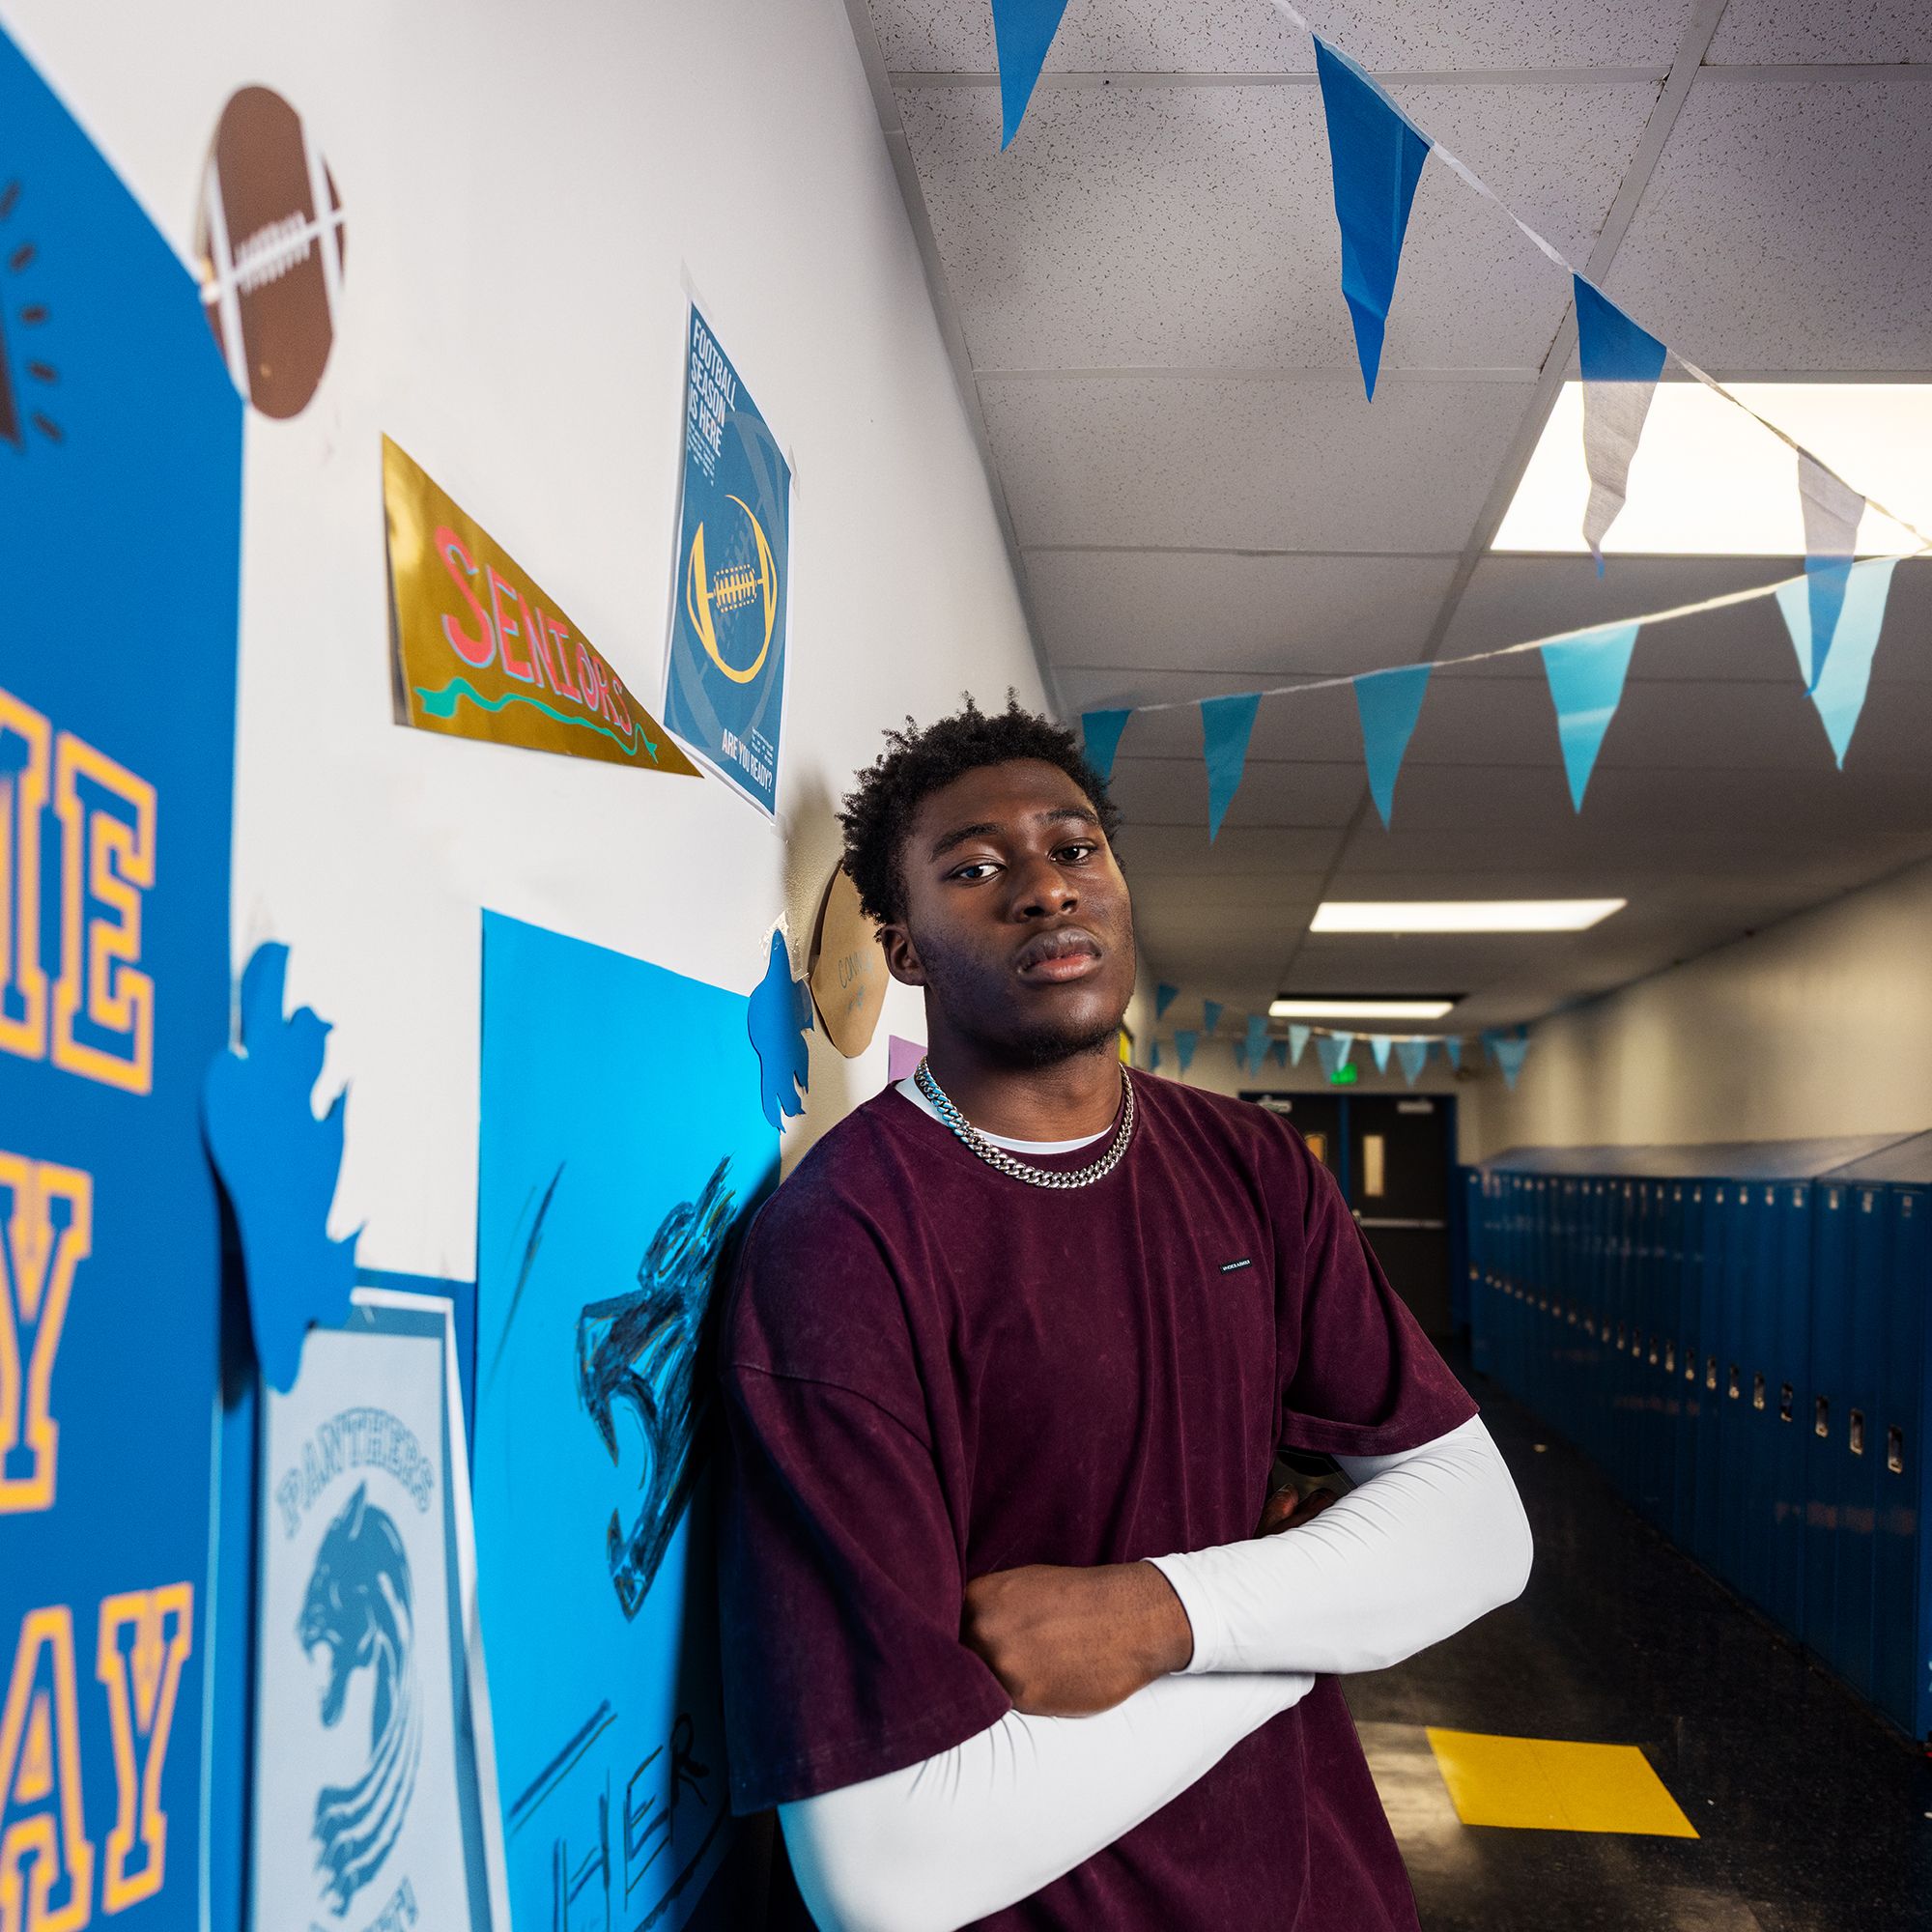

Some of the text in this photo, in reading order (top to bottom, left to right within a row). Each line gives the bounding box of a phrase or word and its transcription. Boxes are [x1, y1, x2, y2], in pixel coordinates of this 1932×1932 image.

[691, 351, 726, 428] SEASON
[693, 318, 736, 412] FOOTBALL
[687, 383, 698, 420] IS
[698, 399, 723, 458] HERE
[434, 525, 633, 736] SENIORS
[722, 727, 739, 761] ARE
[738, 740, 751, 773] YOU
[750, 753, 773, 793] READY?
[274, 1406, 434, 1540] PANTHERS
